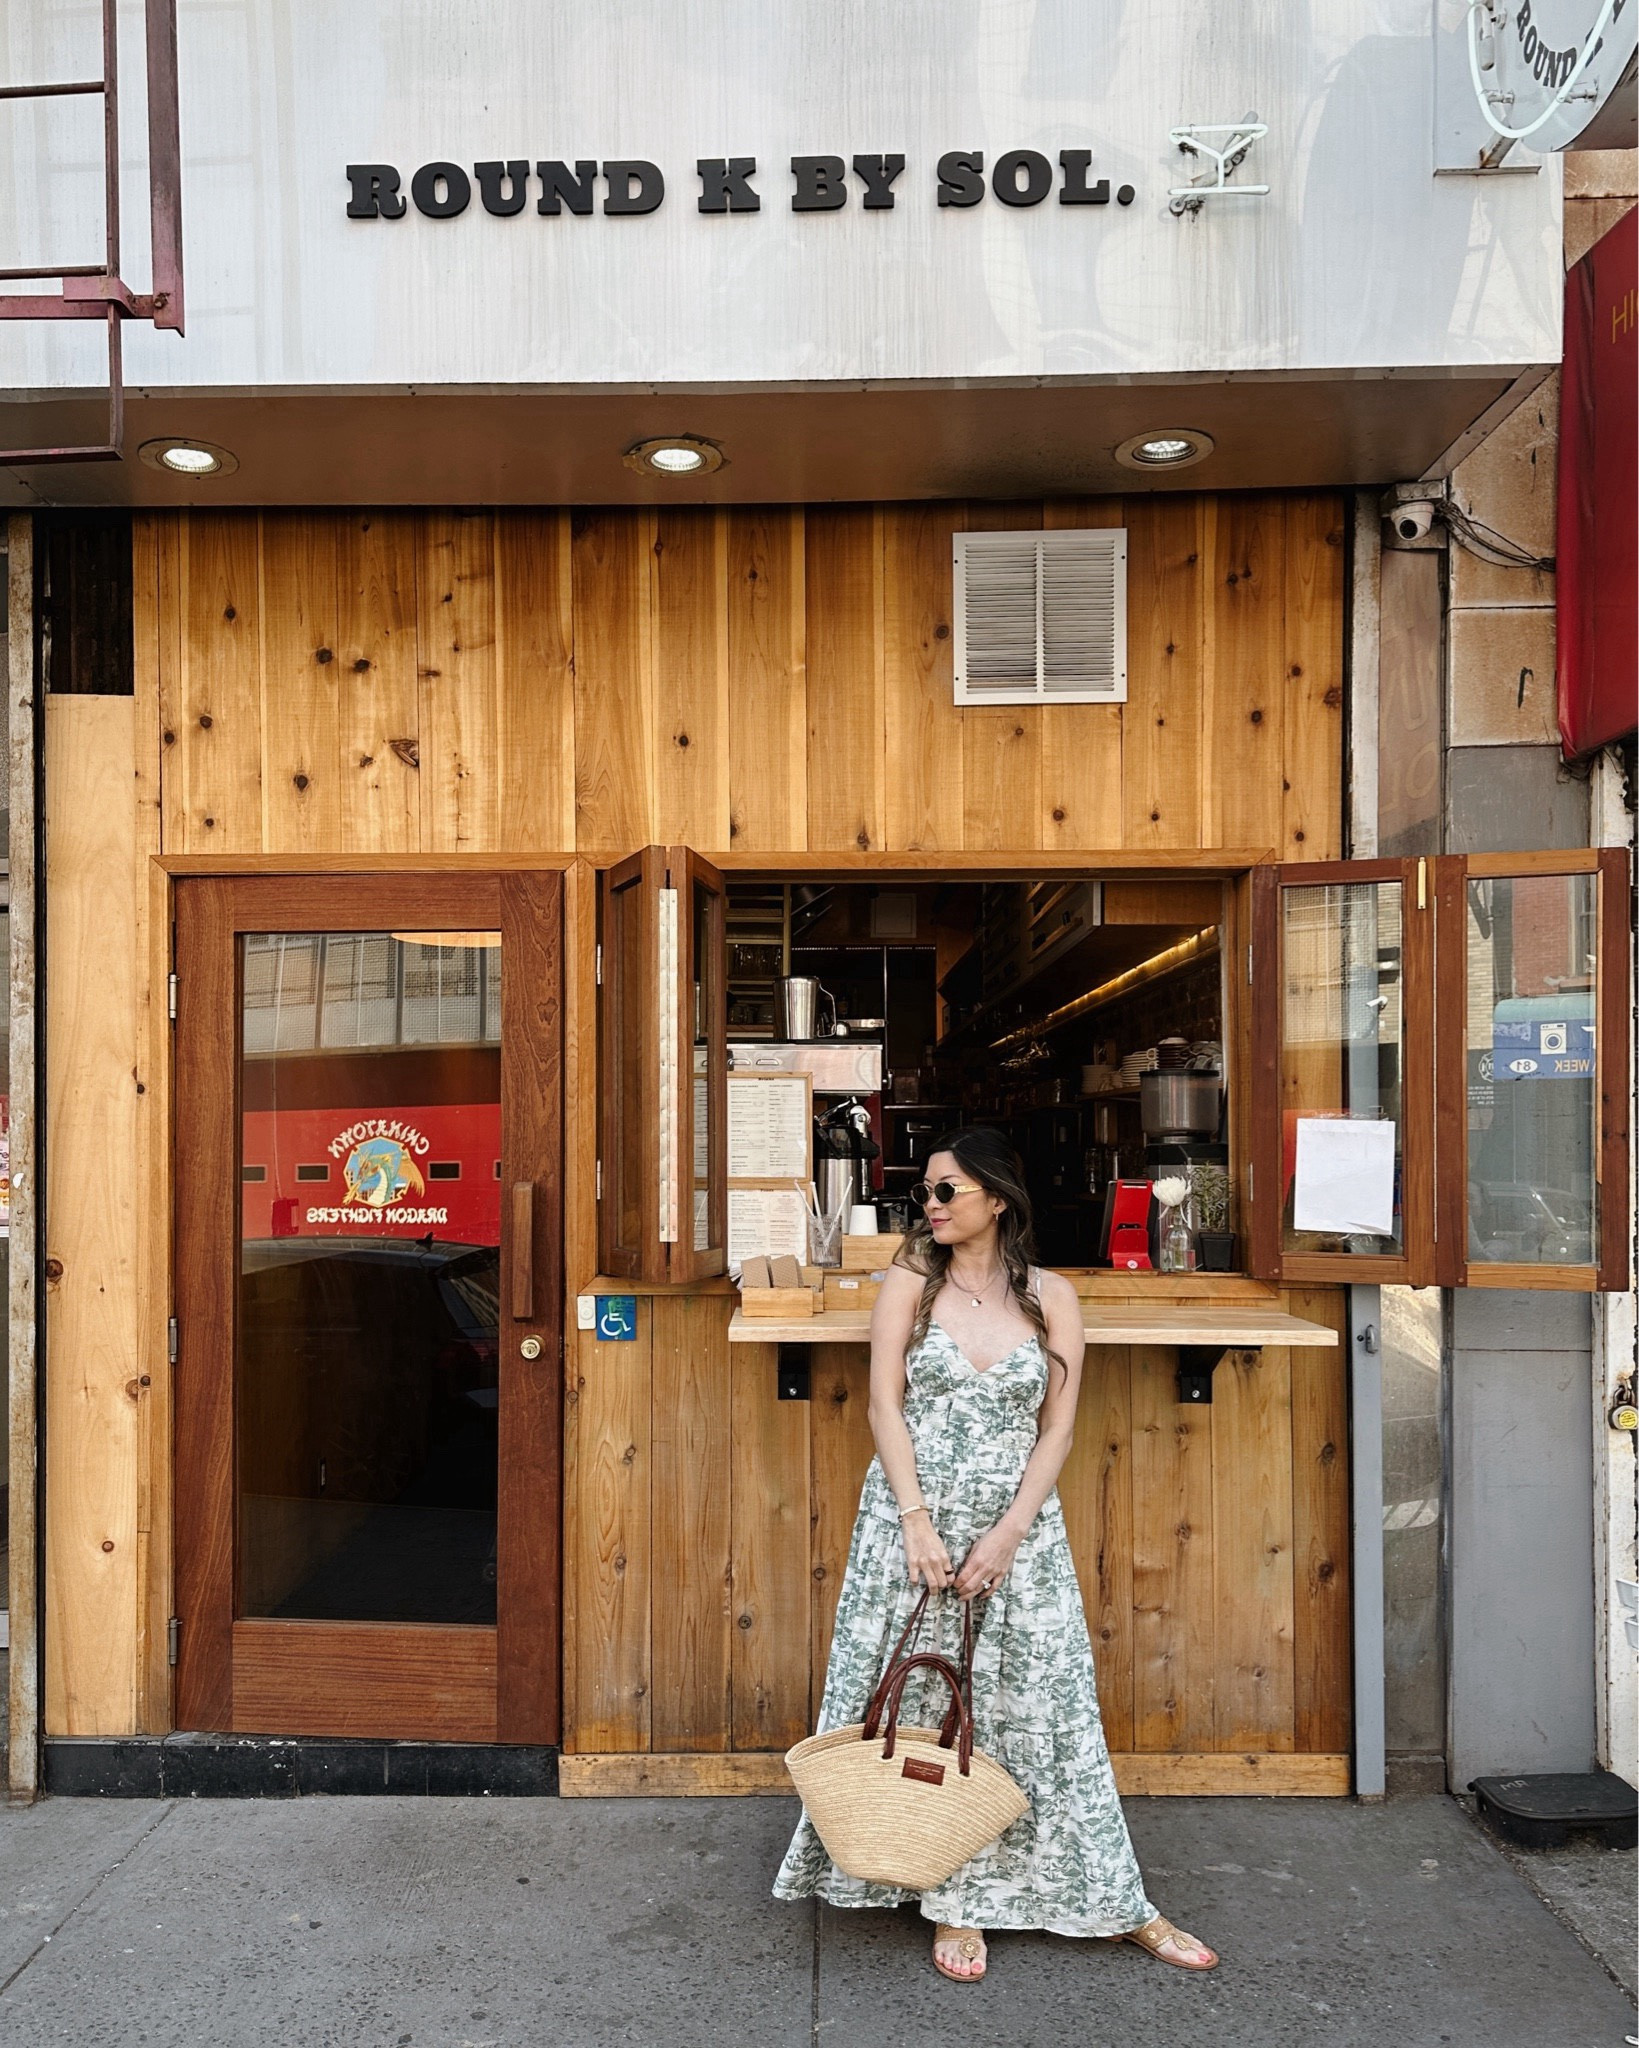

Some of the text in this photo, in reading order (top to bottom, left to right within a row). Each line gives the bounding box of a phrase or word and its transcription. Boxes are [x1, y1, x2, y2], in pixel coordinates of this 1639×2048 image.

[1516, 0, 1577, 88] ROUND
[346, 149, 1136, 221] ROUND K BY SOL.
[1612, 289, 1638, 344] HI
